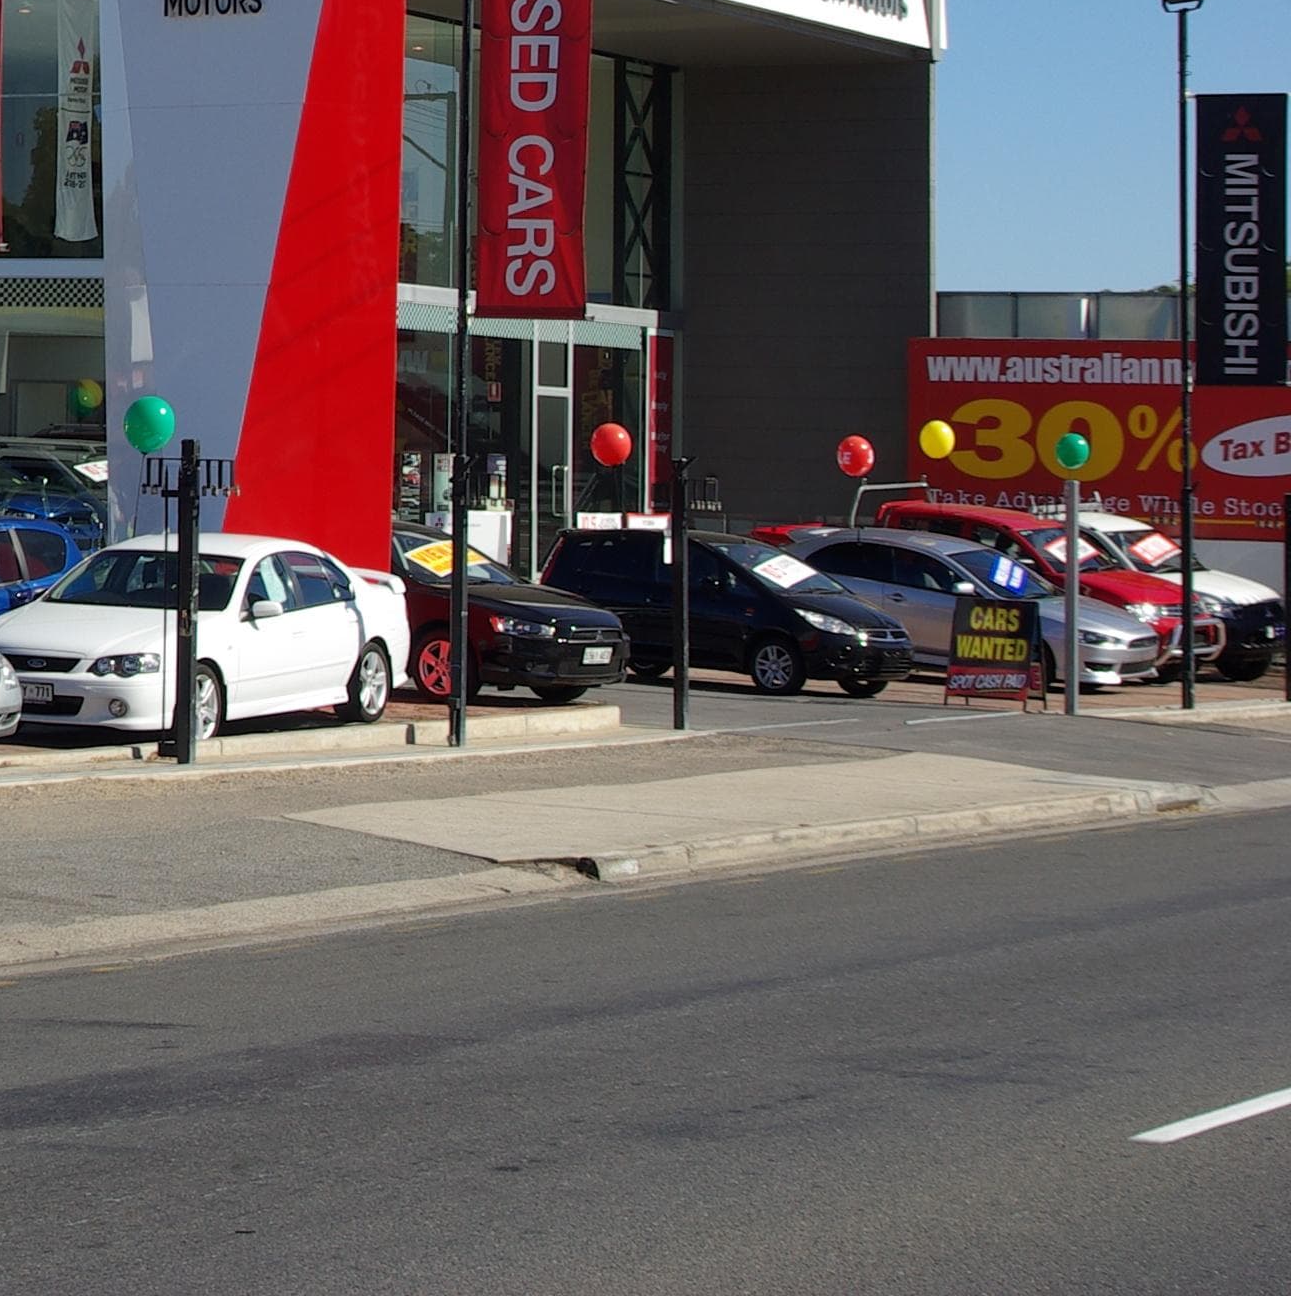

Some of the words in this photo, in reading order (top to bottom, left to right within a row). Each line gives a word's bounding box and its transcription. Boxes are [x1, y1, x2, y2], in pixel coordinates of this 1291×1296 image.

[505, 135, 555, 296] CARS
[1223, 154, 1259, 375] MITSUBISHI
[1219, 438, 1266, 462] Tax
[1138, 494, 1216, 516] Whle
[1224, 497, 1284, 517] Stoc
[970, 606, 1020, 632] CARS
[956, 634, 1028, 661] WANTED
[949, 674, 975, 689] SPOT
[975, 674, 1005, 689] CASH
